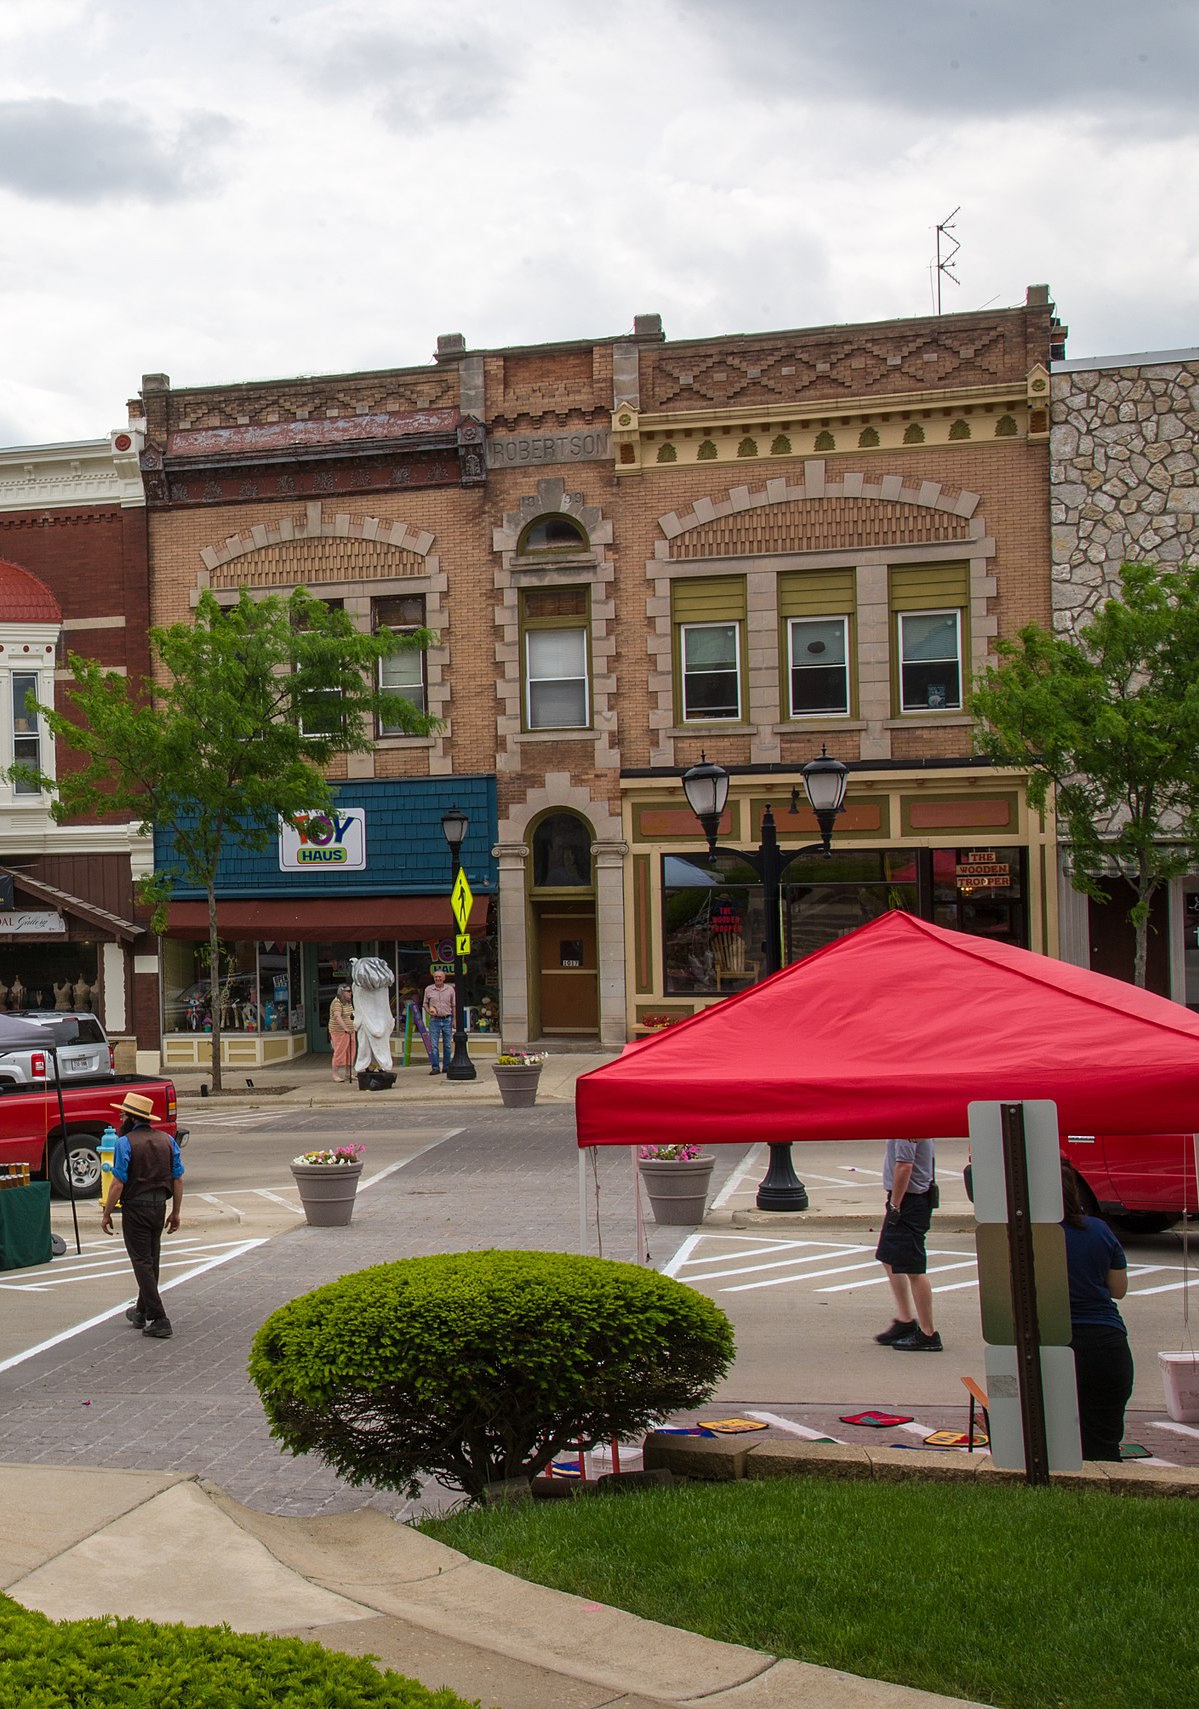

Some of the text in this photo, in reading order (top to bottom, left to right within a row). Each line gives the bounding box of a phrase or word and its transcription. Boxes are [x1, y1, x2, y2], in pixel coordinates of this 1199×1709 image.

[491, 433, 610, 464] ROBERTSON
[302, 850, 343, 861] HAUS
[970, 853, 994, 862] THE
[959, 865, 1008, 874] WOODEN
[957, 877, 1010, 886] TROOPER
[15, 915, 49, 930] Gallery
